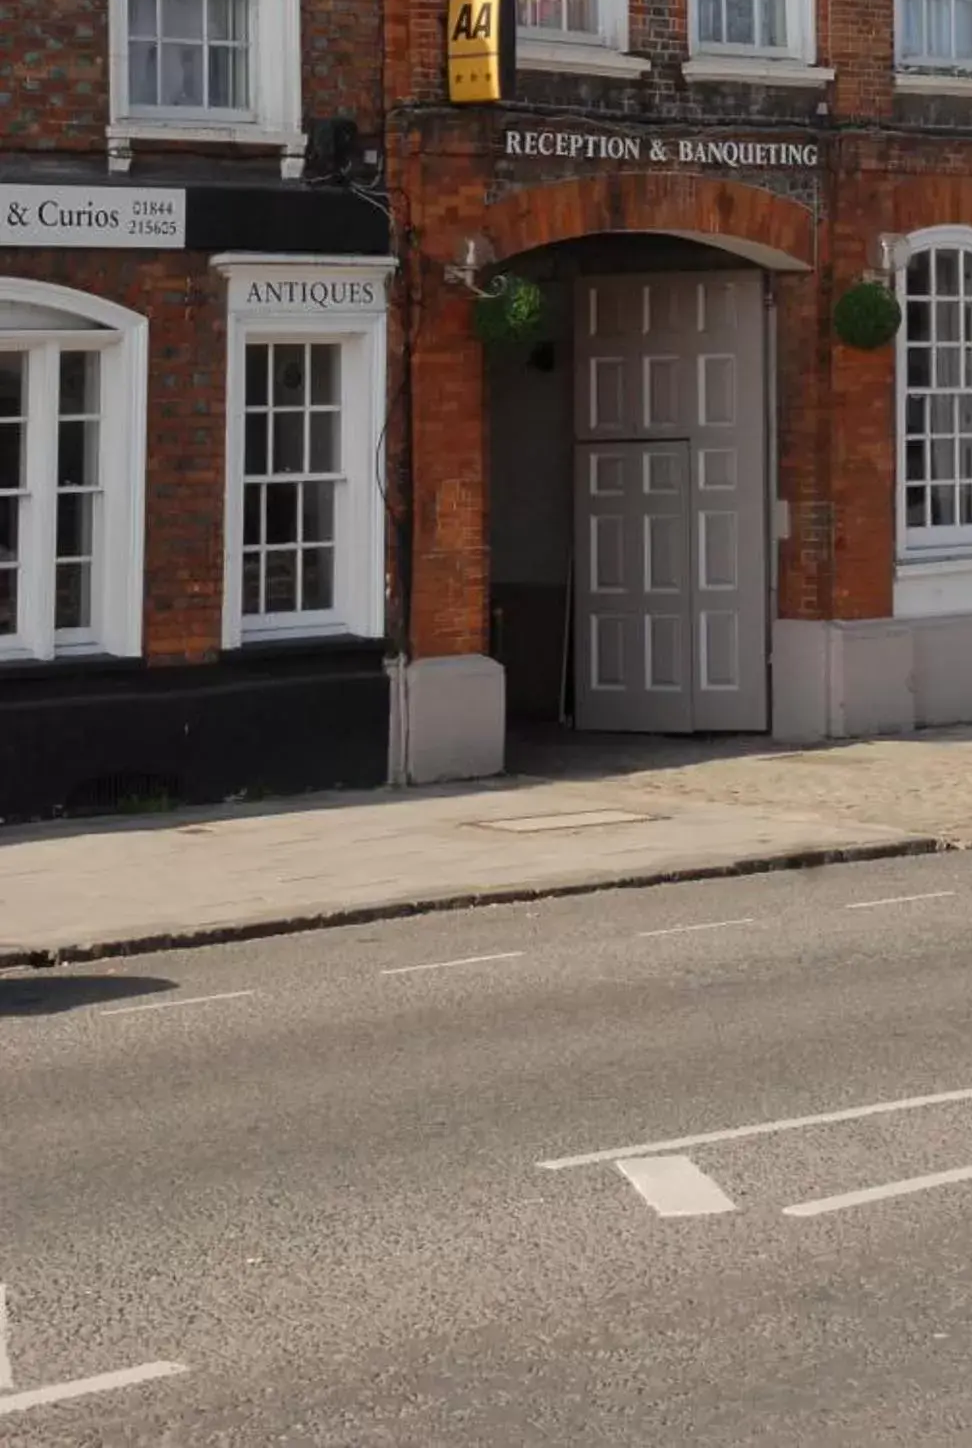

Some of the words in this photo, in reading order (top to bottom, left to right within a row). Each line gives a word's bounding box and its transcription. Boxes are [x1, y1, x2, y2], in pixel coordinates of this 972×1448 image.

[452, 2, 492, 41] AA
[506, 131, 640, 160] RECEPTION
[650, 139, 667, 162] &
[679, 140, 818, 166] BANQUETING
[7, 201, 30, 227] &
[38, 200, 120, 228] Curios
[246, 281, 374, 308] ANTIQUES
